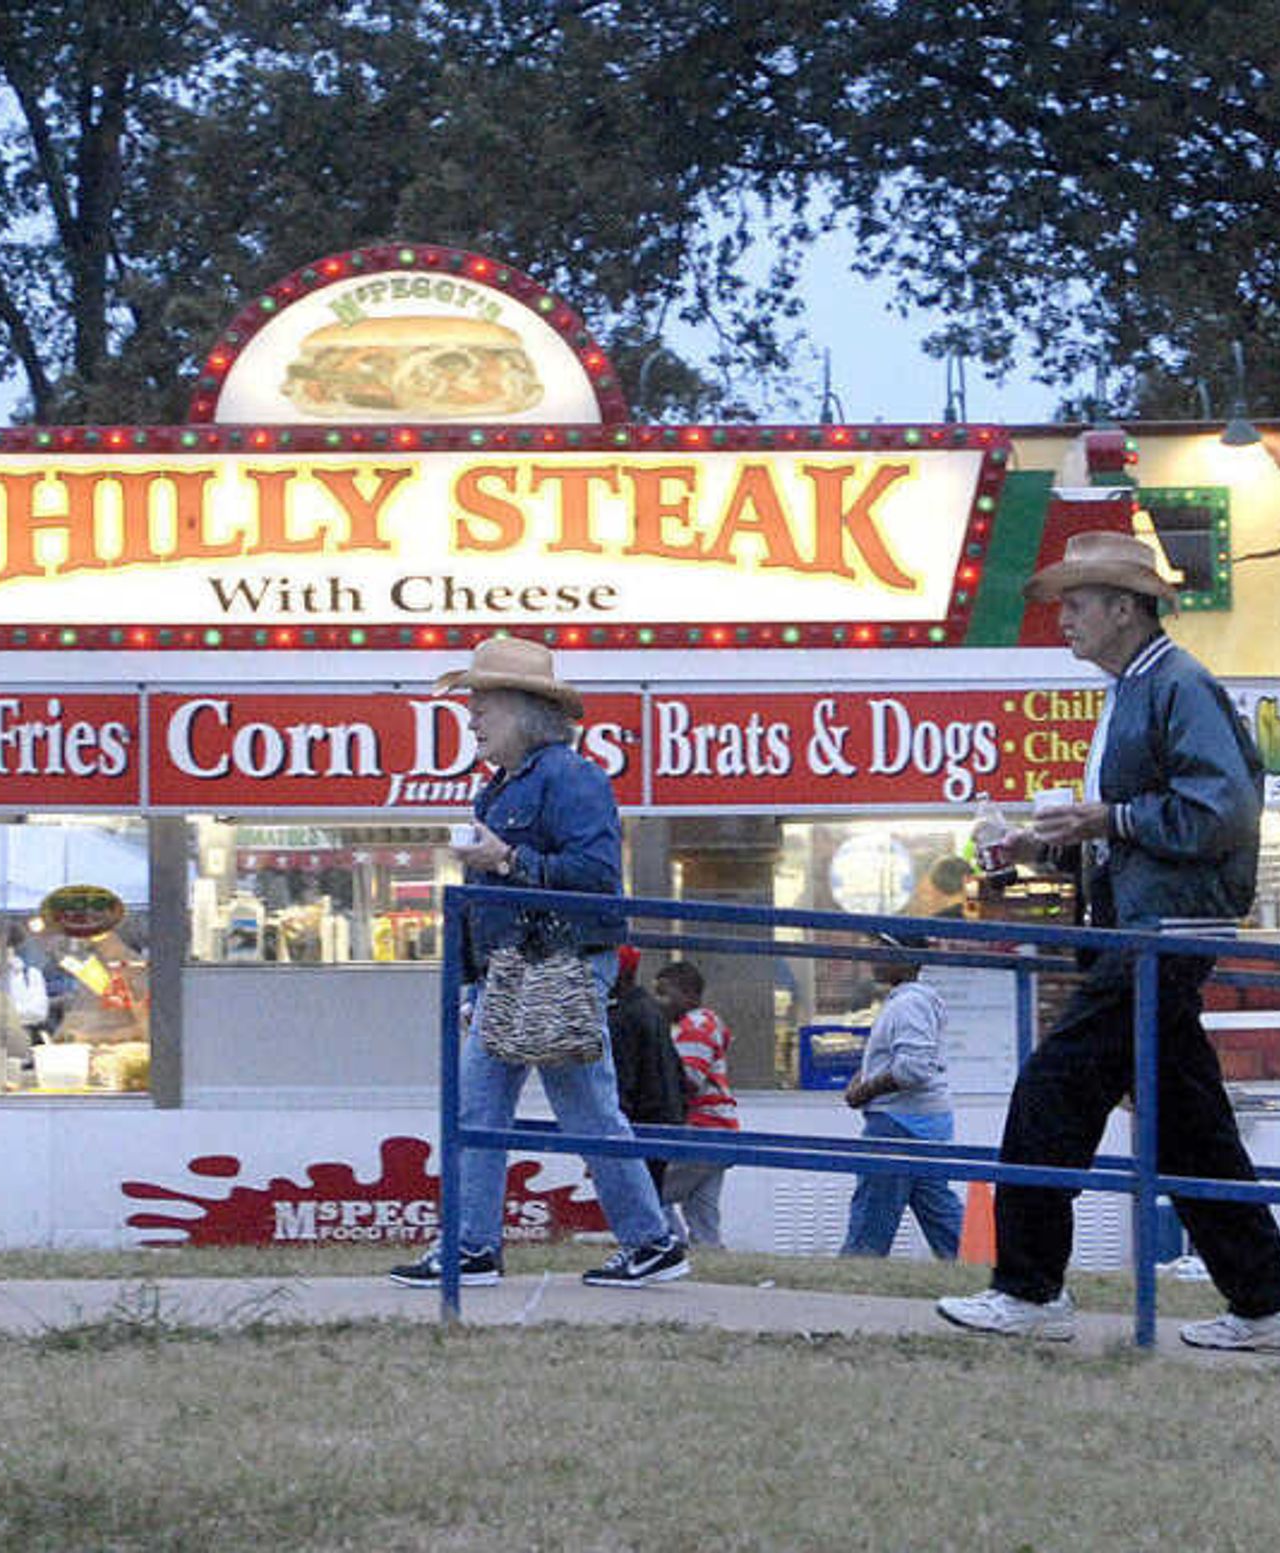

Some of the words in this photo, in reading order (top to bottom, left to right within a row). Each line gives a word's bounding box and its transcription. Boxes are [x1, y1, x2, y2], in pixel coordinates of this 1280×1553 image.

[453, 463, 918, 590] STEAK
[209, 577, 364, 613] With
[390, 577, 619, 613] Cheese
[166, 699, 380, 779] Corn
[655, 700, 792, 776] Brats
[807, 698, 857, 776] &
[868, 699, 999, 804] Dogs
